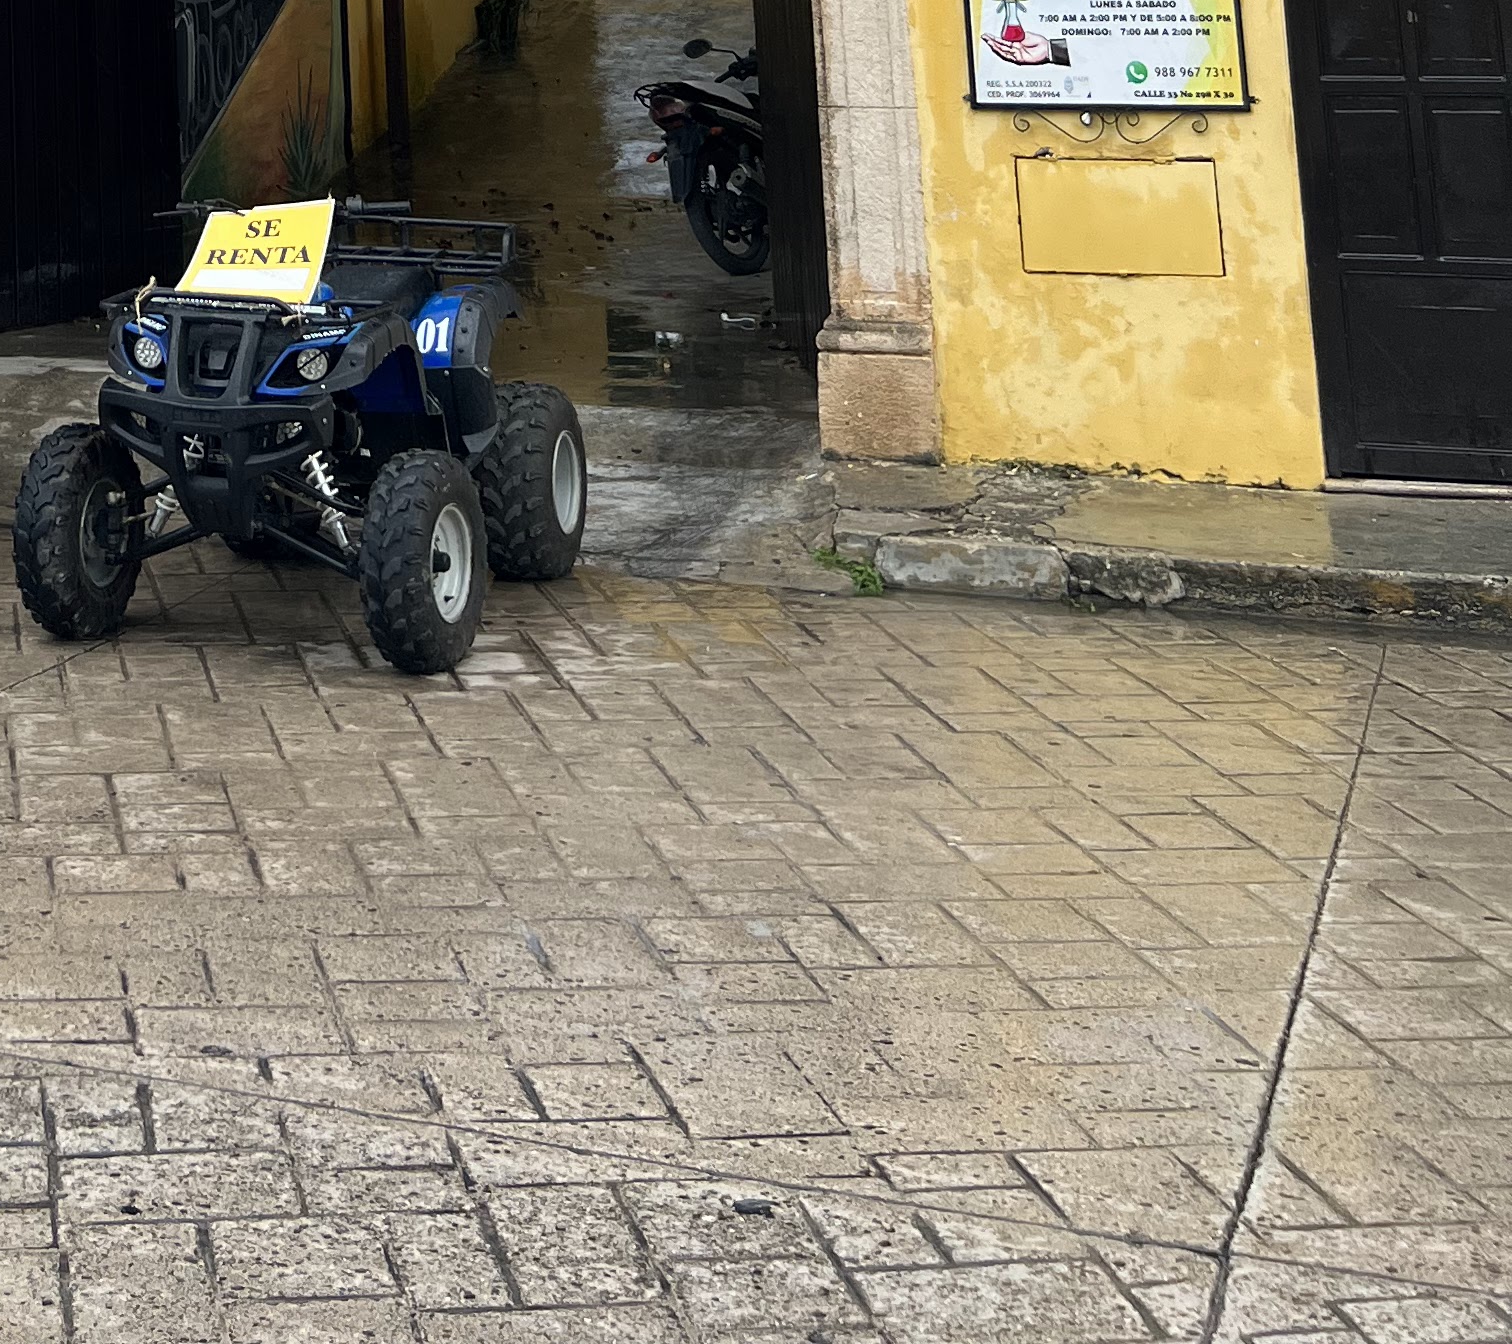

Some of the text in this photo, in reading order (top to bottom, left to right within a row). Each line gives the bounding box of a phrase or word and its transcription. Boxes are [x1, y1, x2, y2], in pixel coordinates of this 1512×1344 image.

[1090, 0, 1177, 8] LUNES A SABADO
[1039, 14, 1059, 22] 7:00
[1062, 14, 1077, 22] AM
[1080, 14, 1087, 22] A
[1089, 14, 1110, 22] 2:00
[1113, 14, 1127, 22] PM
[1130, 14, 1137, 22] Y
[1140, 14, 1153, 22] DE
[1180, 14, 1187, 22] A
[1216, 14, 1231, 22] PM
[1061, 28, 1210, 36] DOMINGO: 7:00 AM A 2:00 PM
[1154, 67, 1233, 77] 988 967 7311
[1134, 90, 1166, 98] CALLE
[245, 218, 282, 238] SE
[205, 245, 311, 265] RENTA
[416, 316, 450, 354] 01
